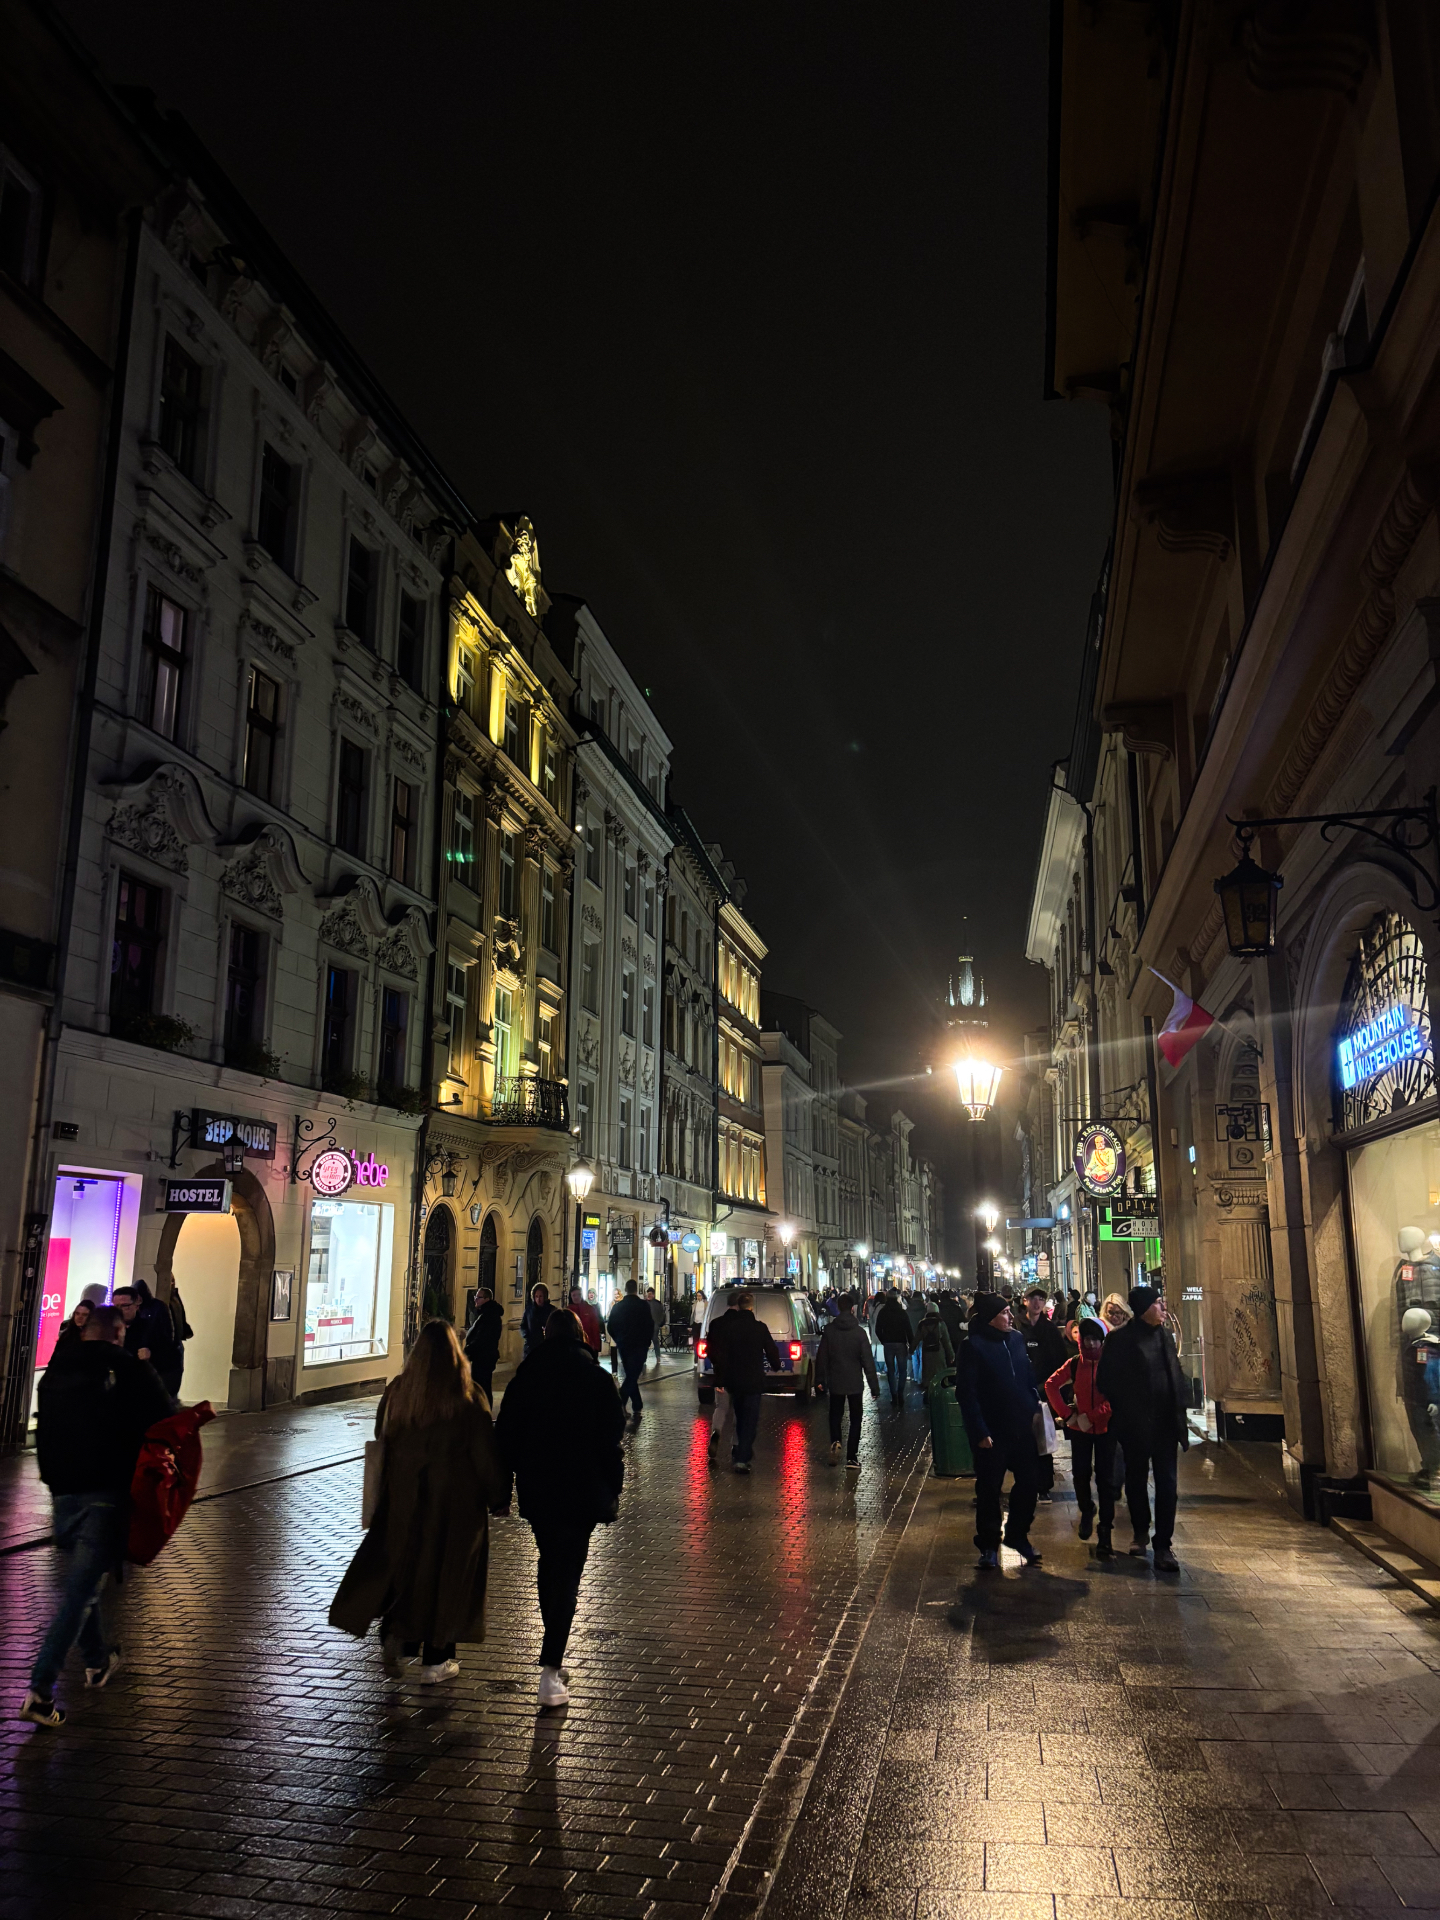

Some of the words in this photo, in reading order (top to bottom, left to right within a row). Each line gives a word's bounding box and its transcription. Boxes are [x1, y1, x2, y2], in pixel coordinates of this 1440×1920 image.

[1353, 1003, 1405, 1057] MOUNTAIN
[1356, 1025, 1421, 1081] WAREHOUSE
[236, 1123, 270, 1151] HOUSE
[1076, 1142, 1084, 1157] PUB
[1082, 1124, 1123, 1155] RESTAURACJA
[169, 1189, 221, 1202] HOSTEL
[1118, 1199, 1156, 1213] OPTYK
